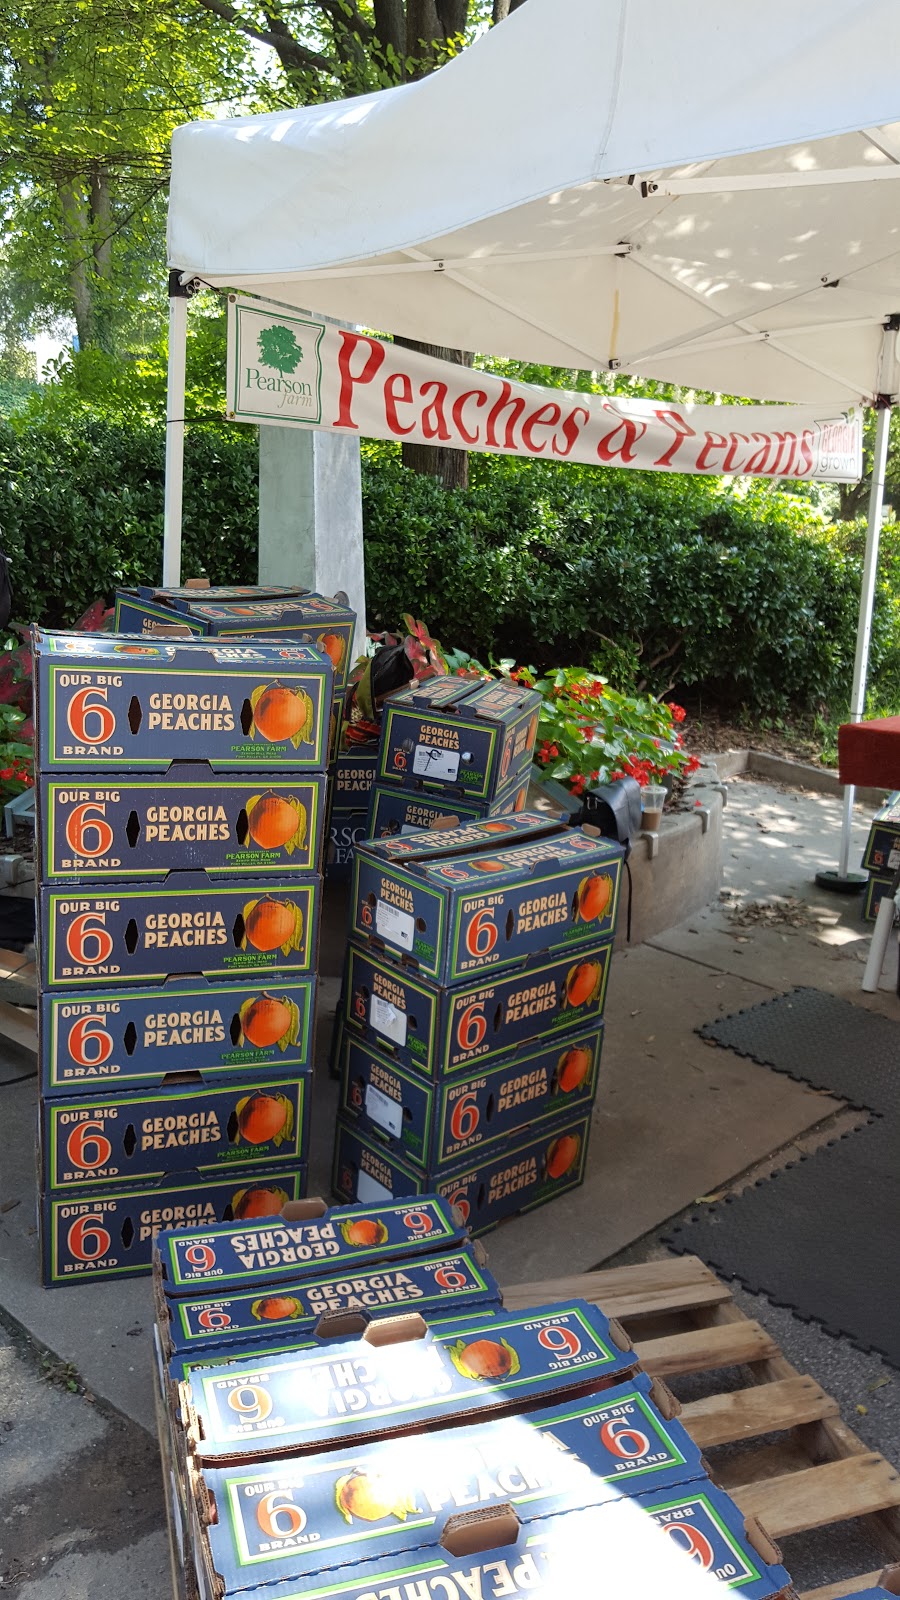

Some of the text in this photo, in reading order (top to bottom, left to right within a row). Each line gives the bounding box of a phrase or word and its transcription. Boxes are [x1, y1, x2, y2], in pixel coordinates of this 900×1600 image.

[245, 367, 312, 397] Pearson
[278, 386, 313, 408] farm
[332, 330, 590, 456] Peaches
[652, 409, 815, 476] Pecans
[822, 424, 855, 453] GEORGIA
[820, 457, 855, 472] grown
[60, 675, 122, 687] OUR BIG
[149, 693, 232, 711] GEORGIA
[67, 687, 116, 745] 6
[148, 713, 235, 731] PEACHES
[419, 733, 460, 750] PEACHES
[420, 725, 459, 740] GEORGIA
[63, 746, 123, 755] BRAND
[394, 751, 407, 768] 6
[337, 780, 372, 791] PEACH
[58, 791, 120, 803] OUR BIG
[147, 806, 227, 822] GEORGIA
[405, 814, 434, 827] PEACH
[407, 805, 444, 819] GEORGIA
[66, 803, 113, 858] 6
[146, 824, 230, 842] PEACHES
[410, 826, 480, 844] PEACHES
[424, 832, 491, 848] GEORGIA
[497, 845, 562, 862] GEORGIA
[569, 839, 597, 849] 6
[62, 858, 121, 868] BRAND
[440, 868, 469, 880] 6
[381, 878, 414, 901] GEORGIA
[381, 886, 415, 913] PEACHES
[60, 901, 120, 914] OUR BIG
[463, 894, 504, 914] OUR BIG
[518, 891, 567, 917] GEORGIA
[146, 912, 225, 930] GEORGIA
[362, 905, 373, 925] 6
[517, 908, 568, 935] PEACHES
[66, 912, 113, 966] 6
[144, 929, 227, 949] PEACHES
[466, 907, 498, 958] 6
[62, 965, 120, 976] BRAND
[460, 953, 500, 970] BRAND
[373, 973, 405, 998] GEORGIA
[508, 981, 556, 1008] GEORGIA
[373, 982, 406, 1010] PEACHES
[456, 989, 495, 1010] OUR BIG
[62, 1003, 120, 1018] OUR BIG
[355, 998, 366, 1017] 6
[505, 995, 557, 1024] PEACHES
[145, 1010, 223, 1029] GEORGIA
[457, 1001, 487, 1050] 6
[68, 1014, 114, 1067] 6
[144, 1027, 225, 1048] PEACHES
[452, 1045, 489, 1064] BRAND
[63, 1065, 120, 1077] BRAND
[370, 1063, 401, 1091] GEORGIA
[370, 1072, 402, 1103] PEACHES
[449, 1079, 486, 1101] OUR BIG
[501, 1068, 547, 1096] GEORGIA
[352, 1084, 362, 1105] 6
[498, 1081, 547, 1112] PEACHES
[60, 1109, 118, 1124] OUR BIG
[142, 1110, 219, 1133] GEORGIA
[451, 1091, 479, 1140] 6
[67, 1120, 112, 1170] 6
[142, 1127, 221, 1151] PEACHES
[446, 1134, 482, 1154] BRAND
[63, 1167, 119, 1180] BRAND
[361, 1150, 392, 1178] GEORGIA
[490, 1157, 537, 1188] GEORGIA
[361, 1160, 393, 1189] PEACHES
[441, 1173, 477, 1197] OUR BIG
[488, 1170, 537, 1205] PEACHES
[61, 1202, 117, 1218] OUR BIG
[140, 1202, 215, 1224] GEORGIA
[394, 1205, 428, 1215] BRAND
[448, 1186, 470, 1226] 6
[403, 1211, 433, 1235] 6
[67, 1213, 111, 1261] 6
[178, 1238, 215, 1247] BRAND
[230, 1223, 337, 1253] PEACHES
[407, 1228, 443, 1241] OUR BIG
[185, 1243, 216, 1272] 6
[238, 1241, 340, 1270] GEORGIA
[64, 1259, 118, 1273] BRAND
[185, 1268, 223, 1279] OUR BIG
[424, 1260, 460, 1272] OUR BIG
[306, 1272, 413, 1301] GEORGIA
[434, 1265, 467, 1289] 6
[439, 1284, 477, 1294] BRAND
[310, 1285, 424, 1315] PEACHES
[198, 1308, 231, 1329] 6
[198, 1324, 239, 1333] BRAND
[524, 1316, 569, 1331] BRAND
[538, 1326, 581, 1361] 6
[549, 1351, 598, 1370] OUR BIG
[217, 1374, 270, 1389] BRAND
[227, 1384, 273, 1424] 6
[583, 1403, 635, 1427] OUR BIG
[600, 1418, 650, 1459] 6
[615, 1452, 667, 1472] BRAND
[244, 1483, 275, 1497] OUR
[256, 1489, 307, 1539] 6
[258, 1533, 321, 1552] BRAND
[715, 1563, 736, 1582] OU
